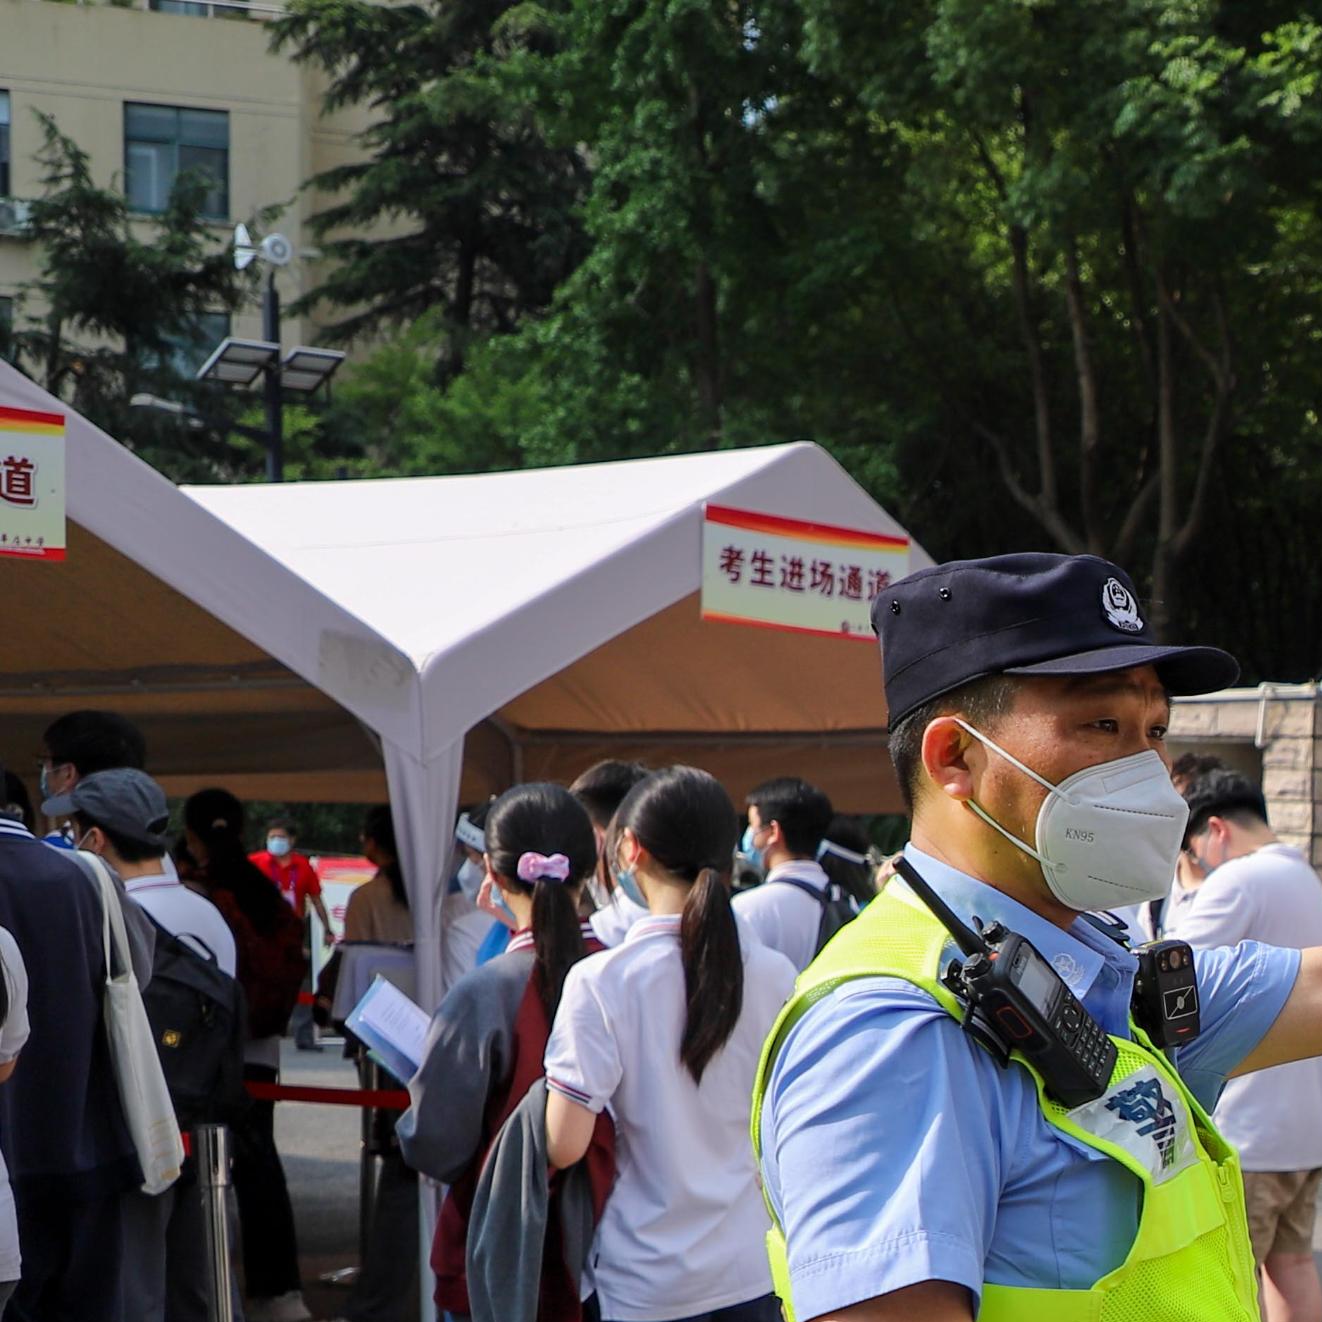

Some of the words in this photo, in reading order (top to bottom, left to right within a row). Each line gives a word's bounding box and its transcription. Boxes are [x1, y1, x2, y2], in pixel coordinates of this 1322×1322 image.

[719, 543, 891, 601] 考生进场通道
[1065, 827, 1095, 843] KN95
